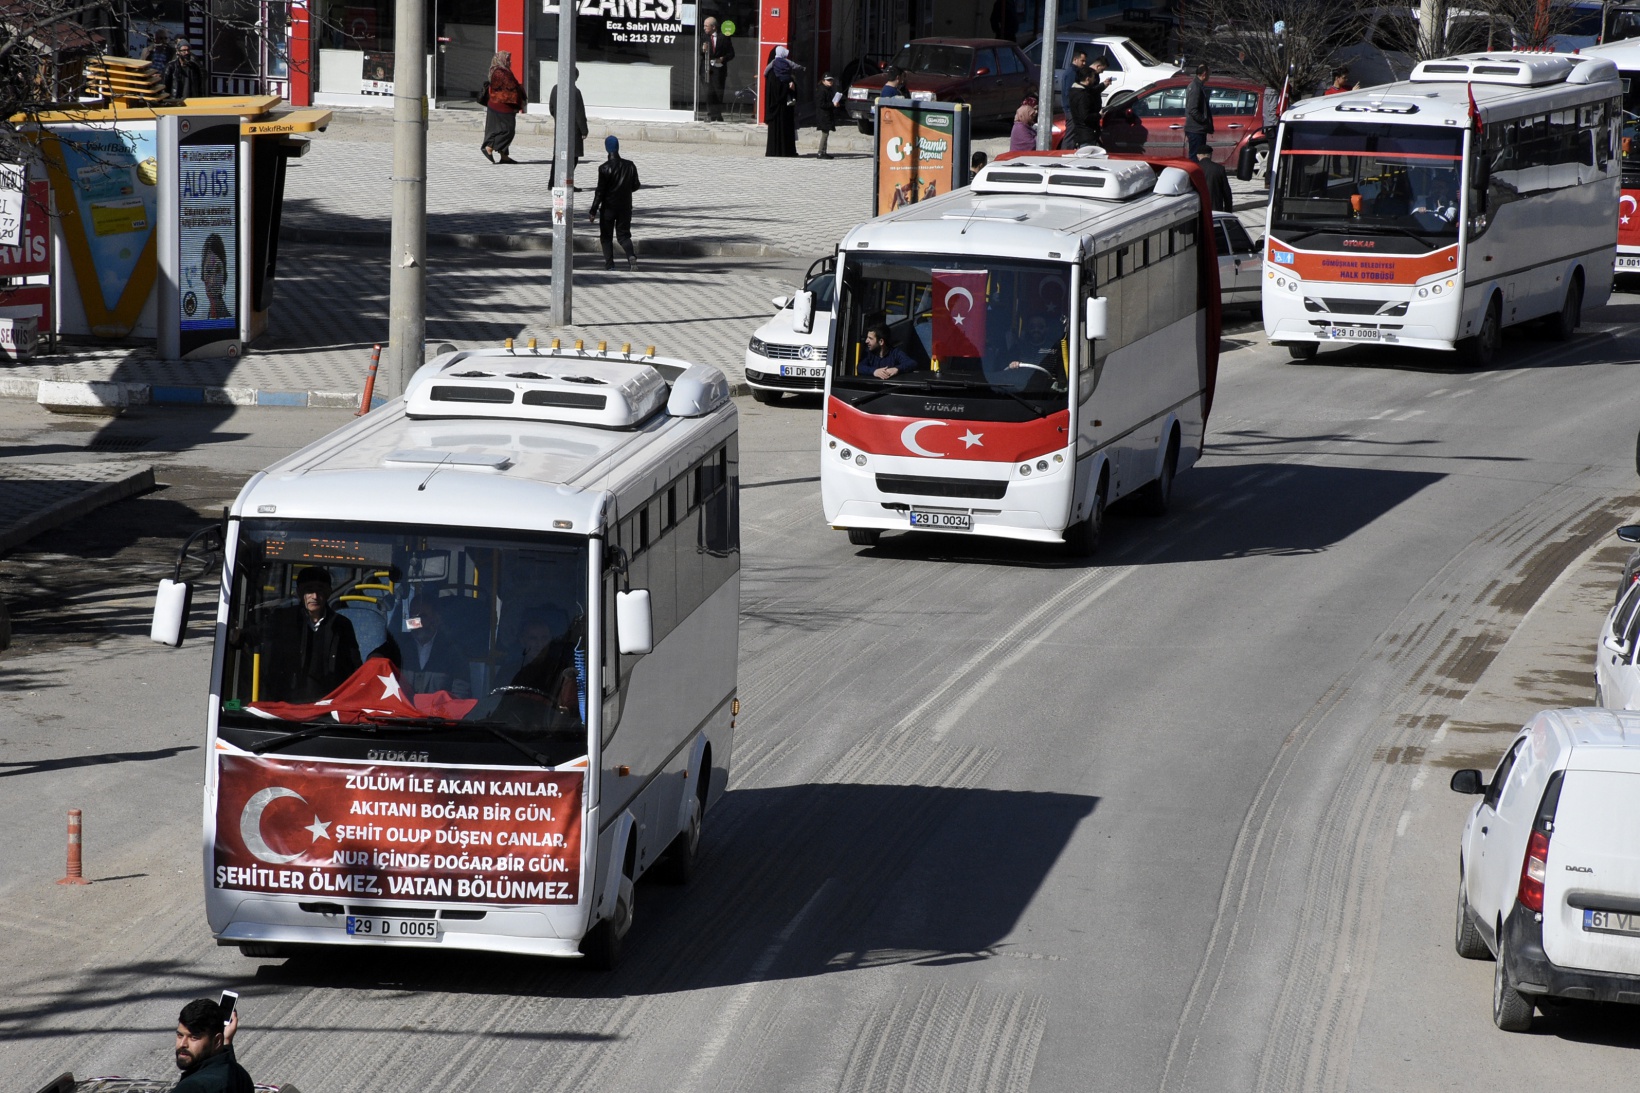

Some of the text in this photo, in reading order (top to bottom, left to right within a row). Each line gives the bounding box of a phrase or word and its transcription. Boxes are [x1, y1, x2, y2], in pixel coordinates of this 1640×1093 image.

[606, 21, 683, 33] Ecz. Sabri VARAN
[612, 33, 676, 44] Tel: 213 37 67
[916, 137, 947, 152] Vitamin
[211, 169, 229, 198] 153
[1343, 240, 1375, 248] OTOKAR
[1321, 259, 1395, 269] GÜMÜŞHANE BELEDİYESİ
[1340, 271, 1395, 280] HALK OTOBÜSÜ
[1336, 328, 1377, 338] 29 D 0008
[785, 367, 826, 376] 61 DR 087
[924, 402, 965, 413] OTOKAR
[916, 513, 929, 524] 29
[932, 514, 939, 524] D
[942, 515, 968, 526] 0034
[367, 749, 429, 763] OTOKAR
[345, 772, 562, 798] ZULÜM İLE AKAN KANLAR,
[349, 800, 556, 822] AKITANI BOĞAR BİR GÜN.
[335, 822, 568, 849] ŞEHİT OLUP DÜŞEN CANLAR,
[332, 848, 569, 872] NUR İÇİNDE DOĞAR BİR GÜN.
[1565, 865, 1594, 874] DACIA
[216, 863, 574, 899] ŞEHİTLER ÖLMEZ, VATAN BÖLÜNMEZ.
[1593, 911, 1609, 928] 61
[1616, 913, 1640, 930] VL
[355, 919, 372, 933] 29
[382, 921, 390, 934] D
[400, 921, 435, 936] 0005
